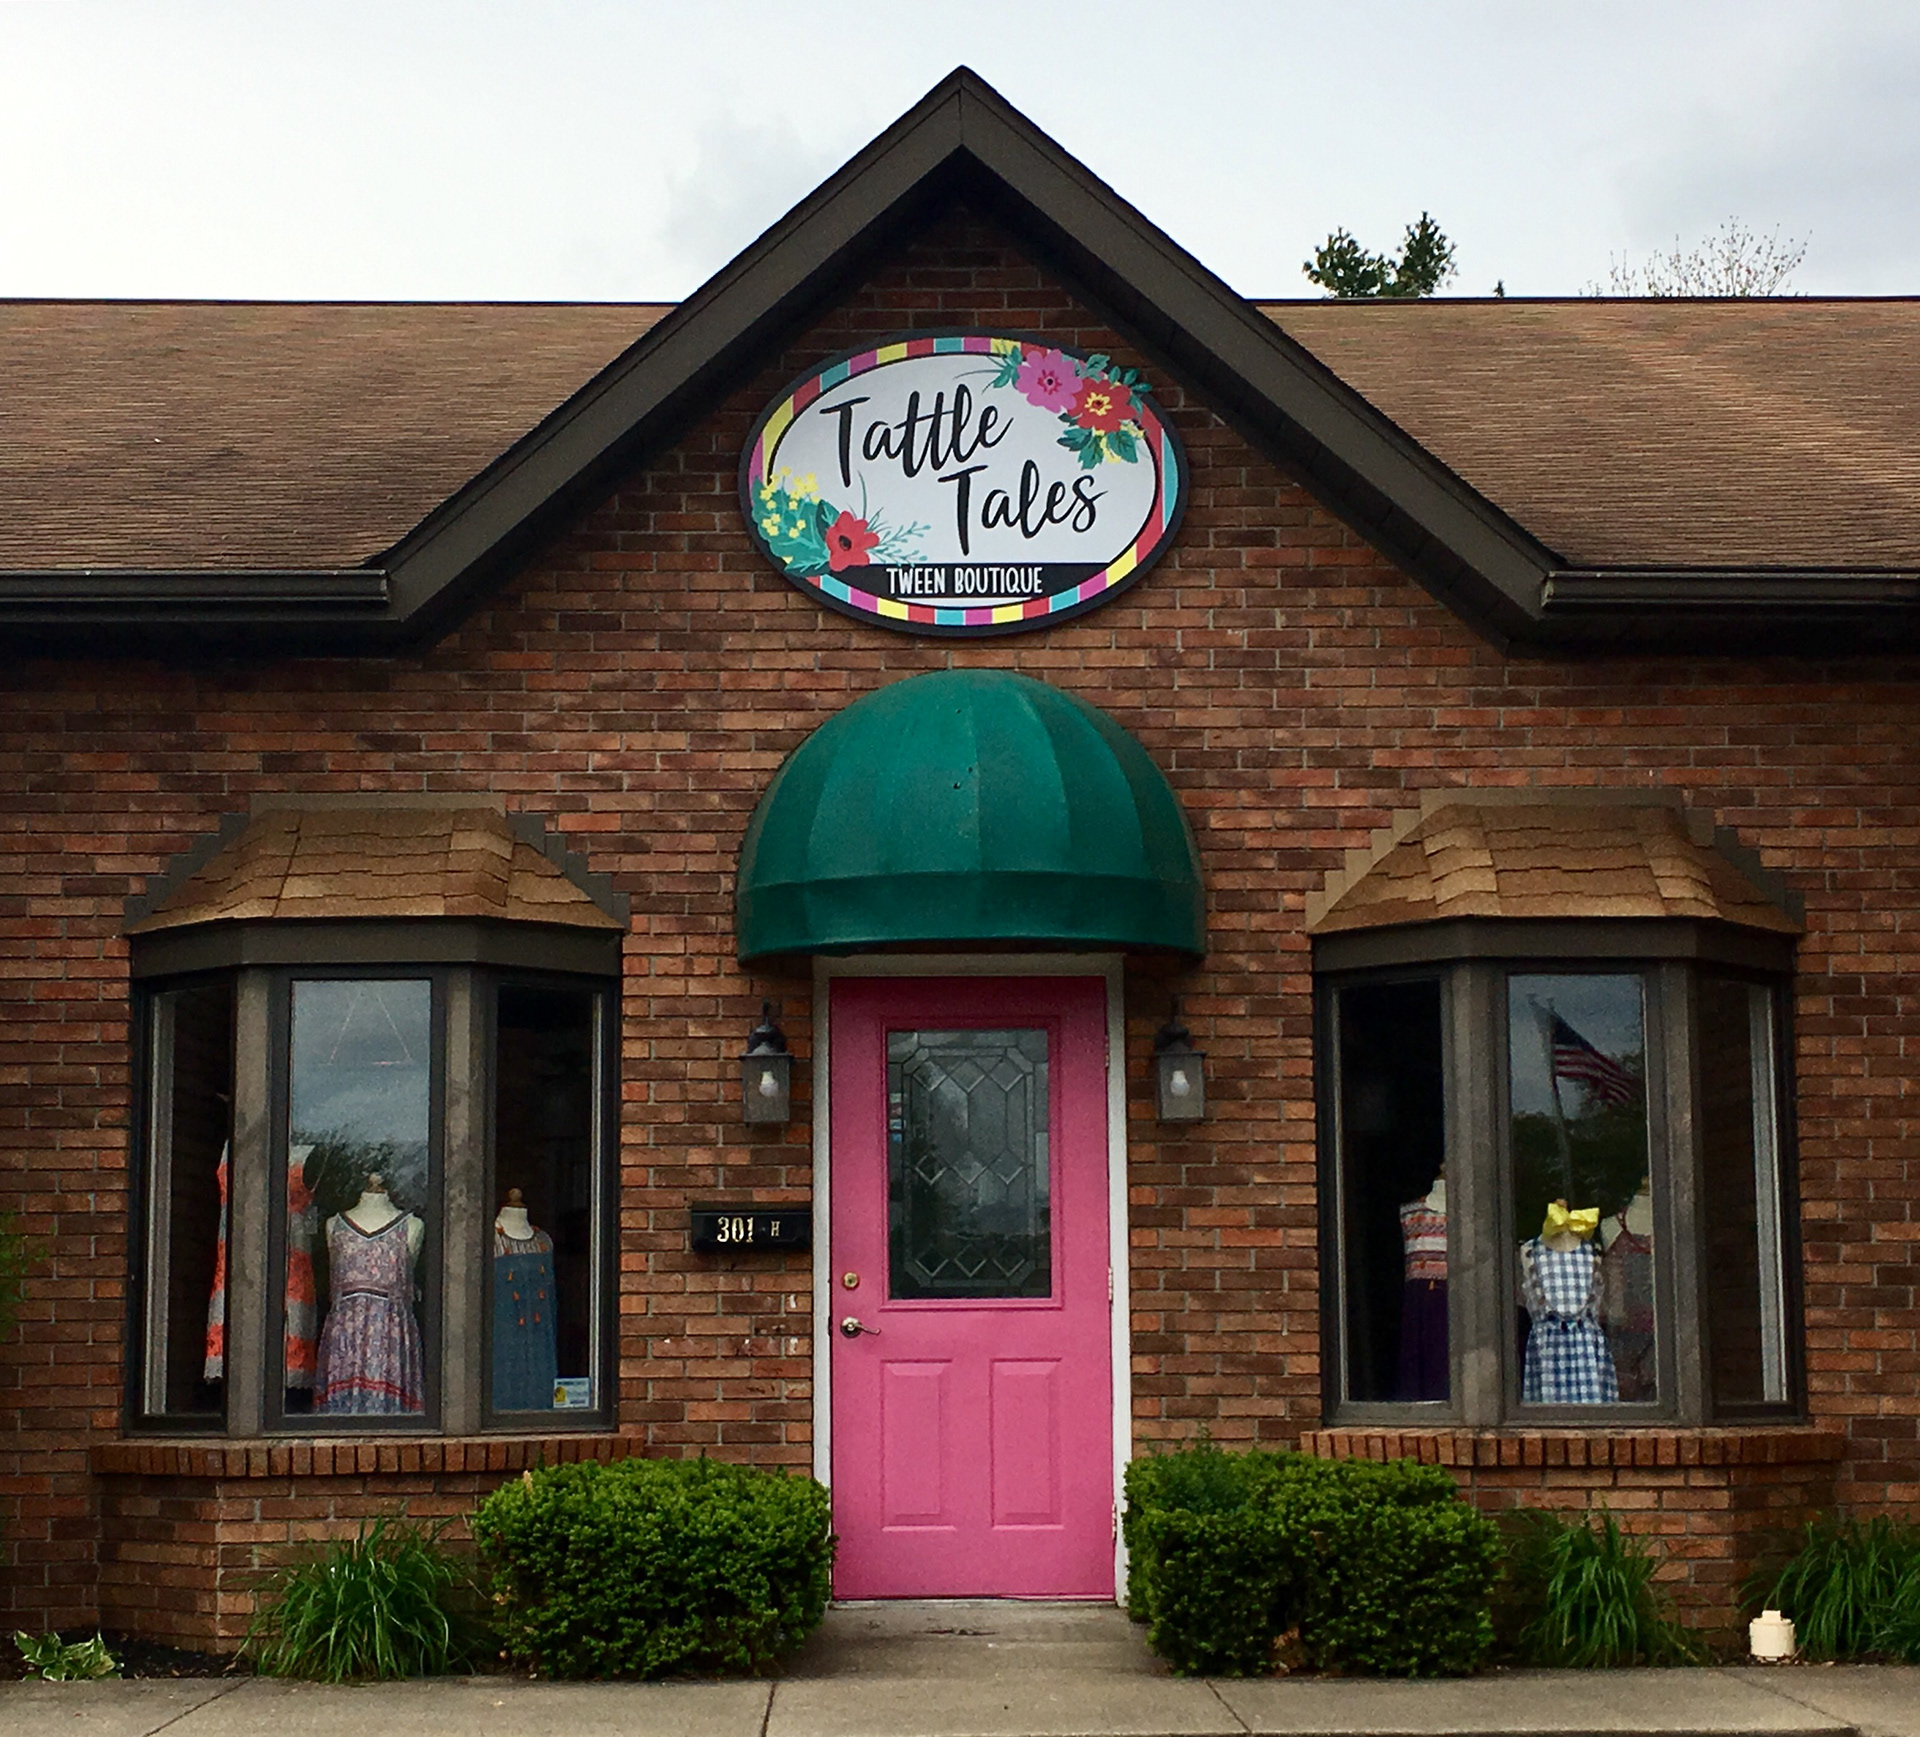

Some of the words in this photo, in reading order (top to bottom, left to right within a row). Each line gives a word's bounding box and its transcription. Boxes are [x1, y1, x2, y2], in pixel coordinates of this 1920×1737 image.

[820, 383, 1014, 488] Tattle
[938, 459, 1108, 556] Tales
[886, 567, 945, 595] TWEEN
[954, 567, 1043, 595] BOUTIQUE
[717, 1216, 754, 1243] 301
[770, 1220, 780, 1237] H
